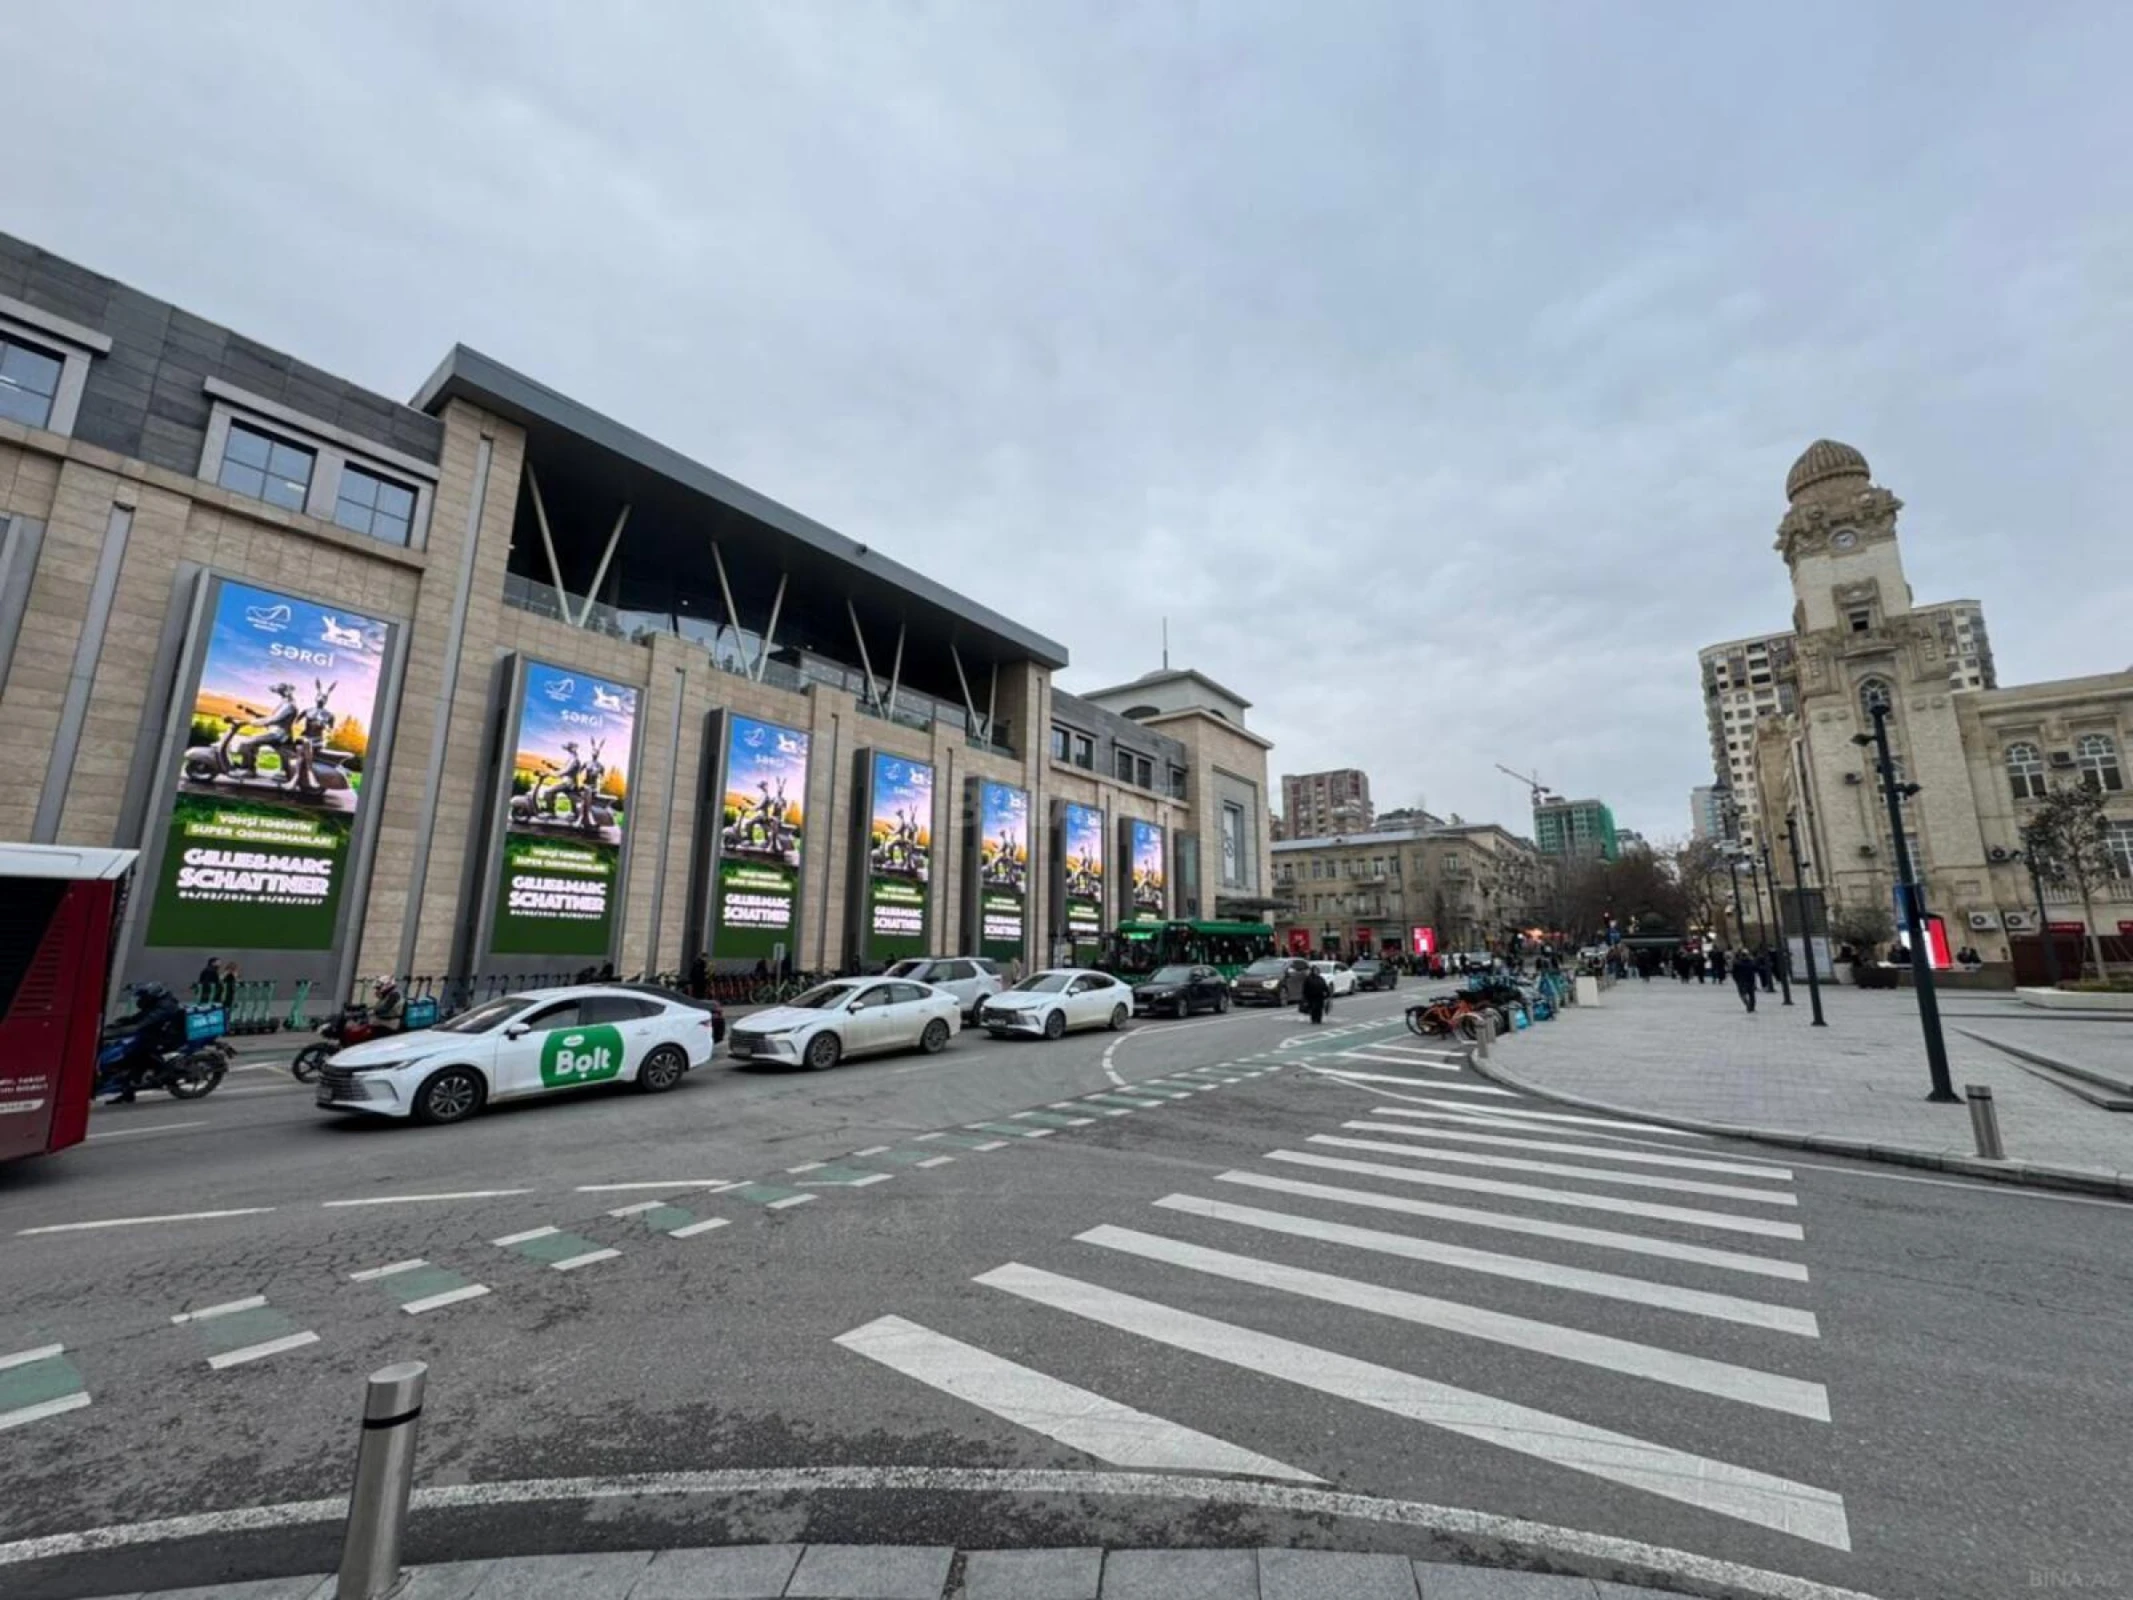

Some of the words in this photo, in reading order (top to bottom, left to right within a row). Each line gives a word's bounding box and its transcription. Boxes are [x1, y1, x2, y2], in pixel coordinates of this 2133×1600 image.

[269, 642, 334, 668] SƏRGİ
[176, 867, 330, 895] SCHATTNER
[556, 1047, 610, 1078] Bolt
